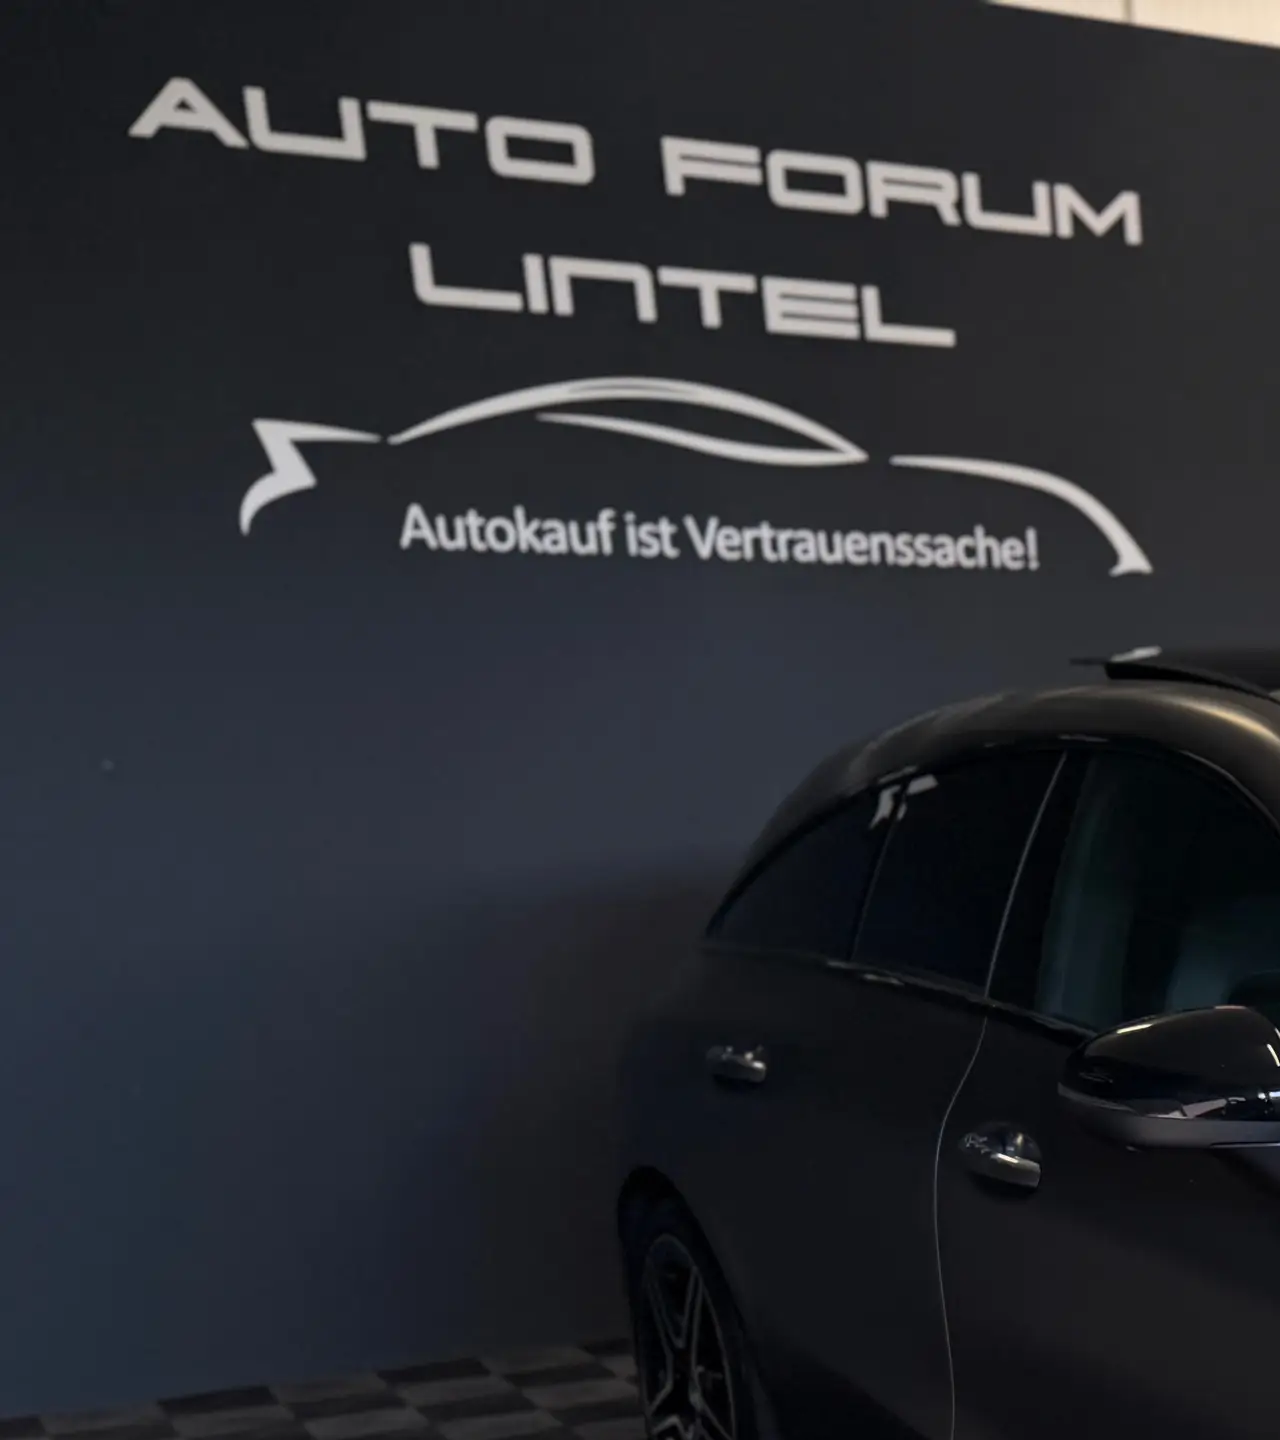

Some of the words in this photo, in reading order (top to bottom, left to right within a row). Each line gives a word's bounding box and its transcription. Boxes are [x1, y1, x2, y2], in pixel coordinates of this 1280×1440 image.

[129, 77, 595, 185] AUTO
[660, 135, 1143, 246] FORUM
[409, 243, 957, 348] LINTEL
[399, 502, 616, 557] Autokauf
[623, 511, 680, 559] ist
[684, 515, 1040, 571] Vertrauenssache!
